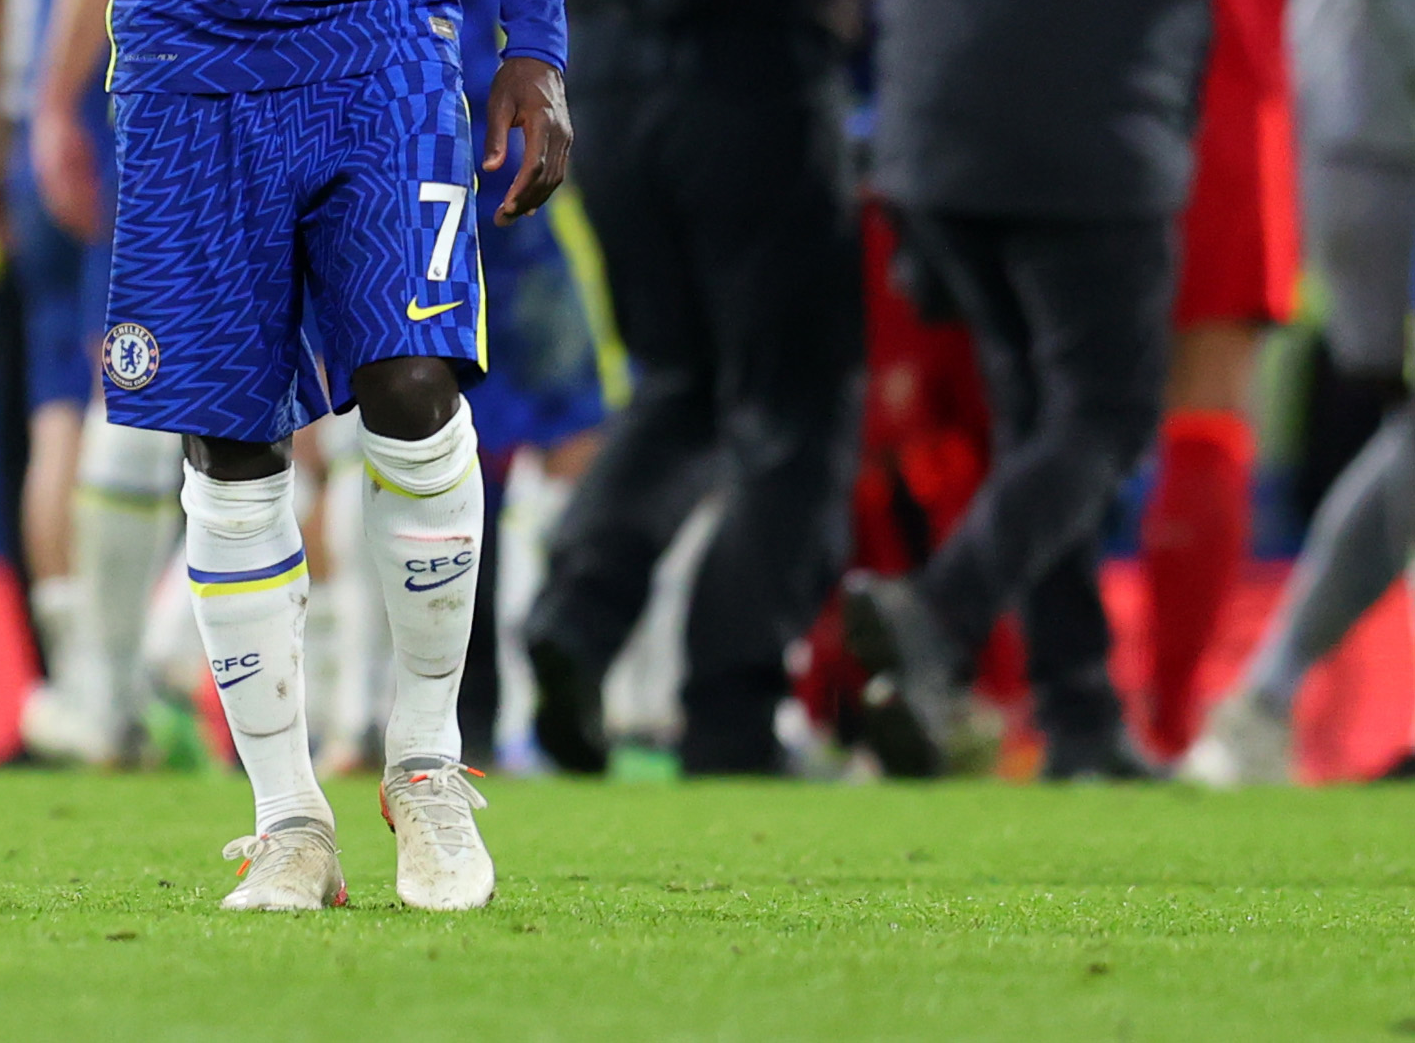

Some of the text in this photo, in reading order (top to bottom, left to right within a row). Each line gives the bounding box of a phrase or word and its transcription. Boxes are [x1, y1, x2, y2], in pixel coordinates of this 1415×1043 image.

[419, 182, 468, 282] 7
[113, 326, 150, 342] CHELSEA
[405, 551, 472, 573] CFC
[212, 653, 260, 672] CFC
